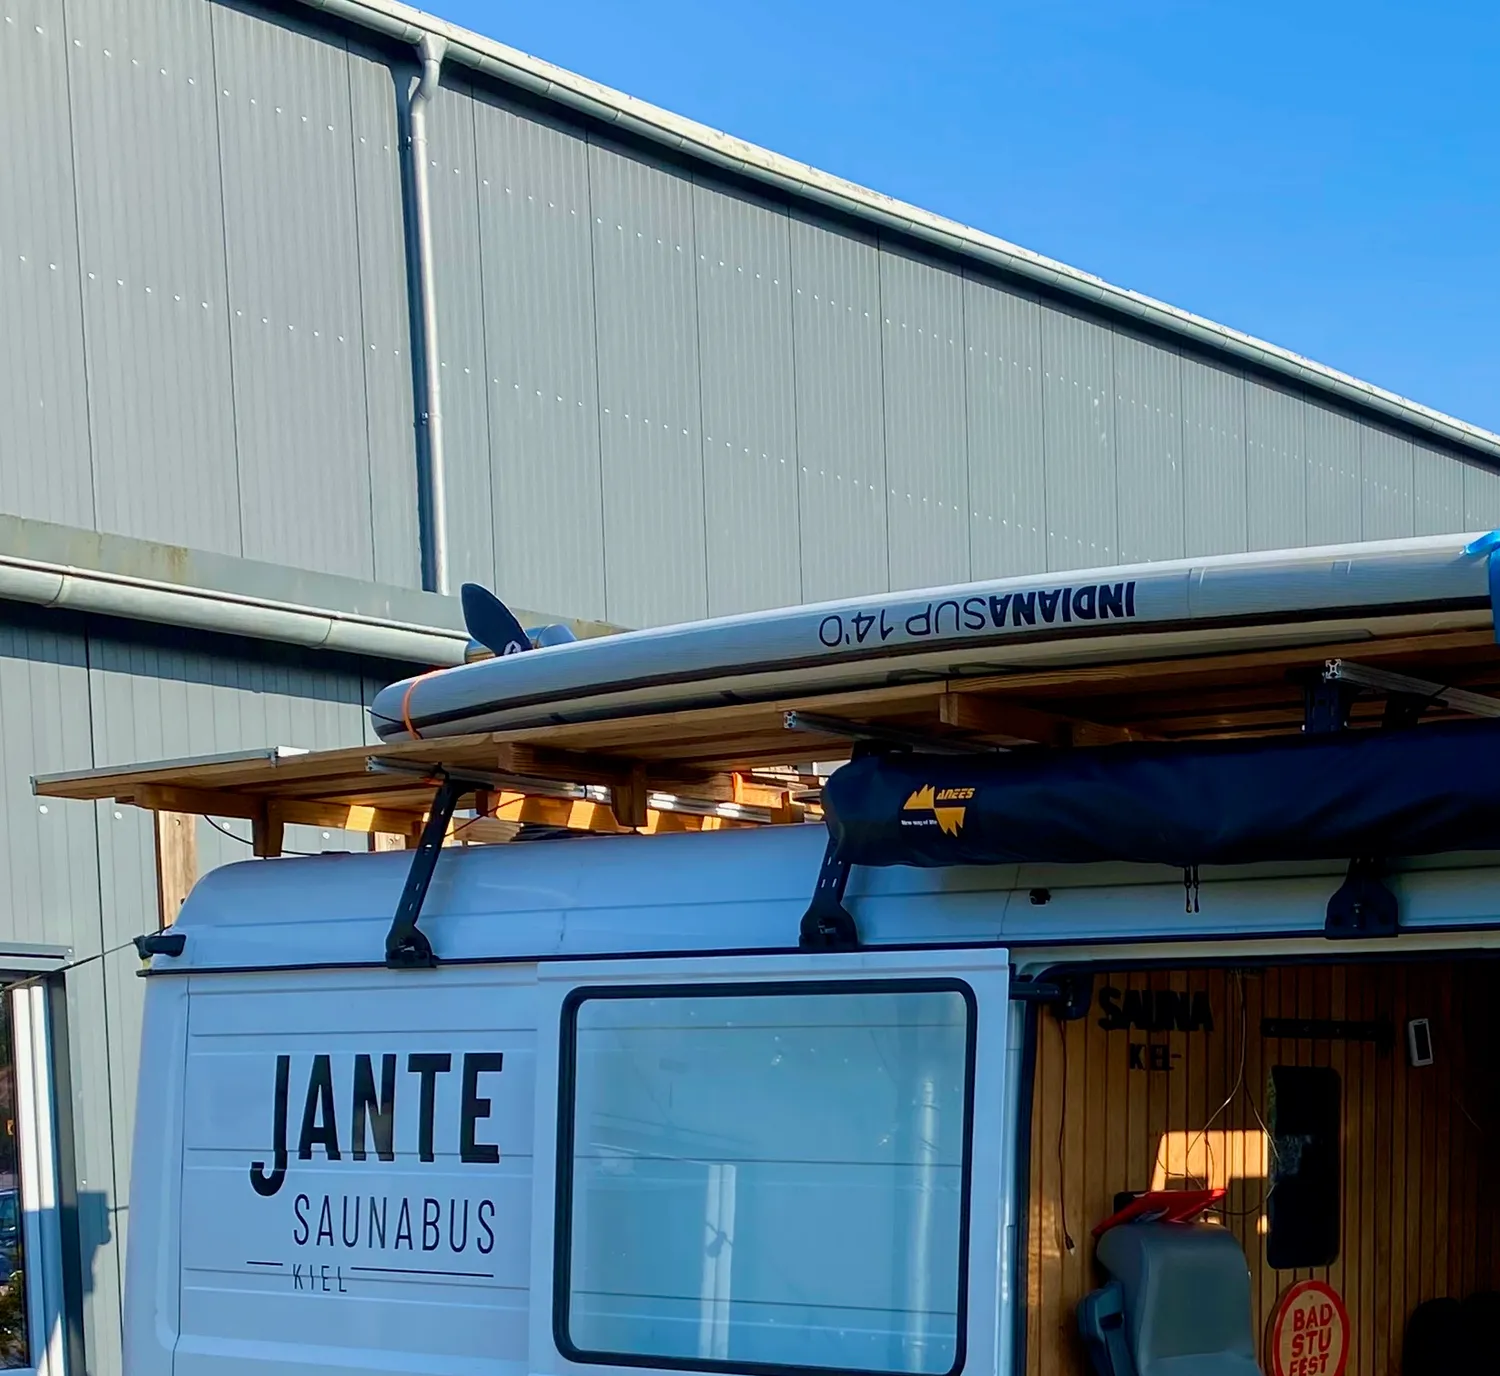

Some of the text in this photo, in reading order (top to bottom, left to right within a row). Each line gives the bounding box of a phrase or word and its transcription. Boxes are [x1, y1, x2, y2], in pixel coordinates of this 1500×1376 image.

[250, 1053, 503, 1197] JANTE
[293, 1193, 496, 1254] SAUNABUS
[292, 1264, 347, 1293] KIEL
[1294, 1304, 1333, 1332] BAD
[1292, 1328, 1332, 1357] STU
